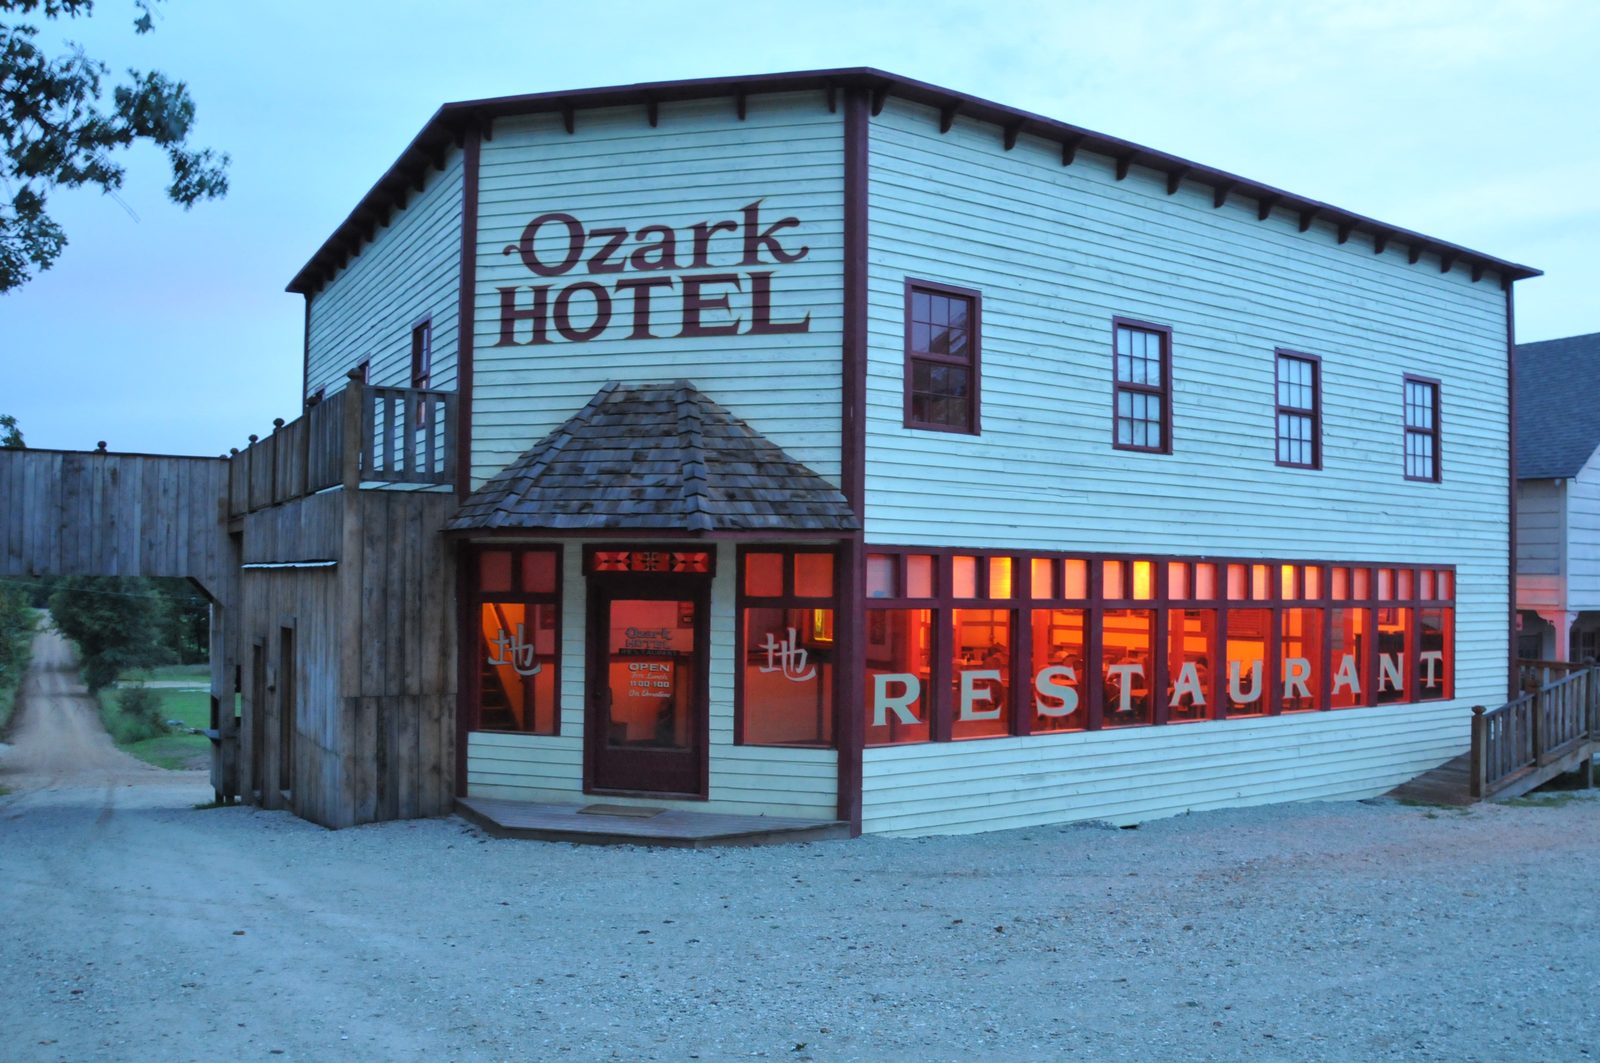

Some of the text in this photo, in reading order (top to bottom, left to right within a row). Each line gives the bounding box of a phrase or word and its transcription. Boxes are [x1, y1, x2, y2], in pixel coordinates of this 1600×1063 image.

[502, 197, 810, 277] Ozark
[492, 271, 811, 347] HOTEL
[629, 663, 670, 672] OPEN
[872, 651, 1443, 727] RESTAURANT
